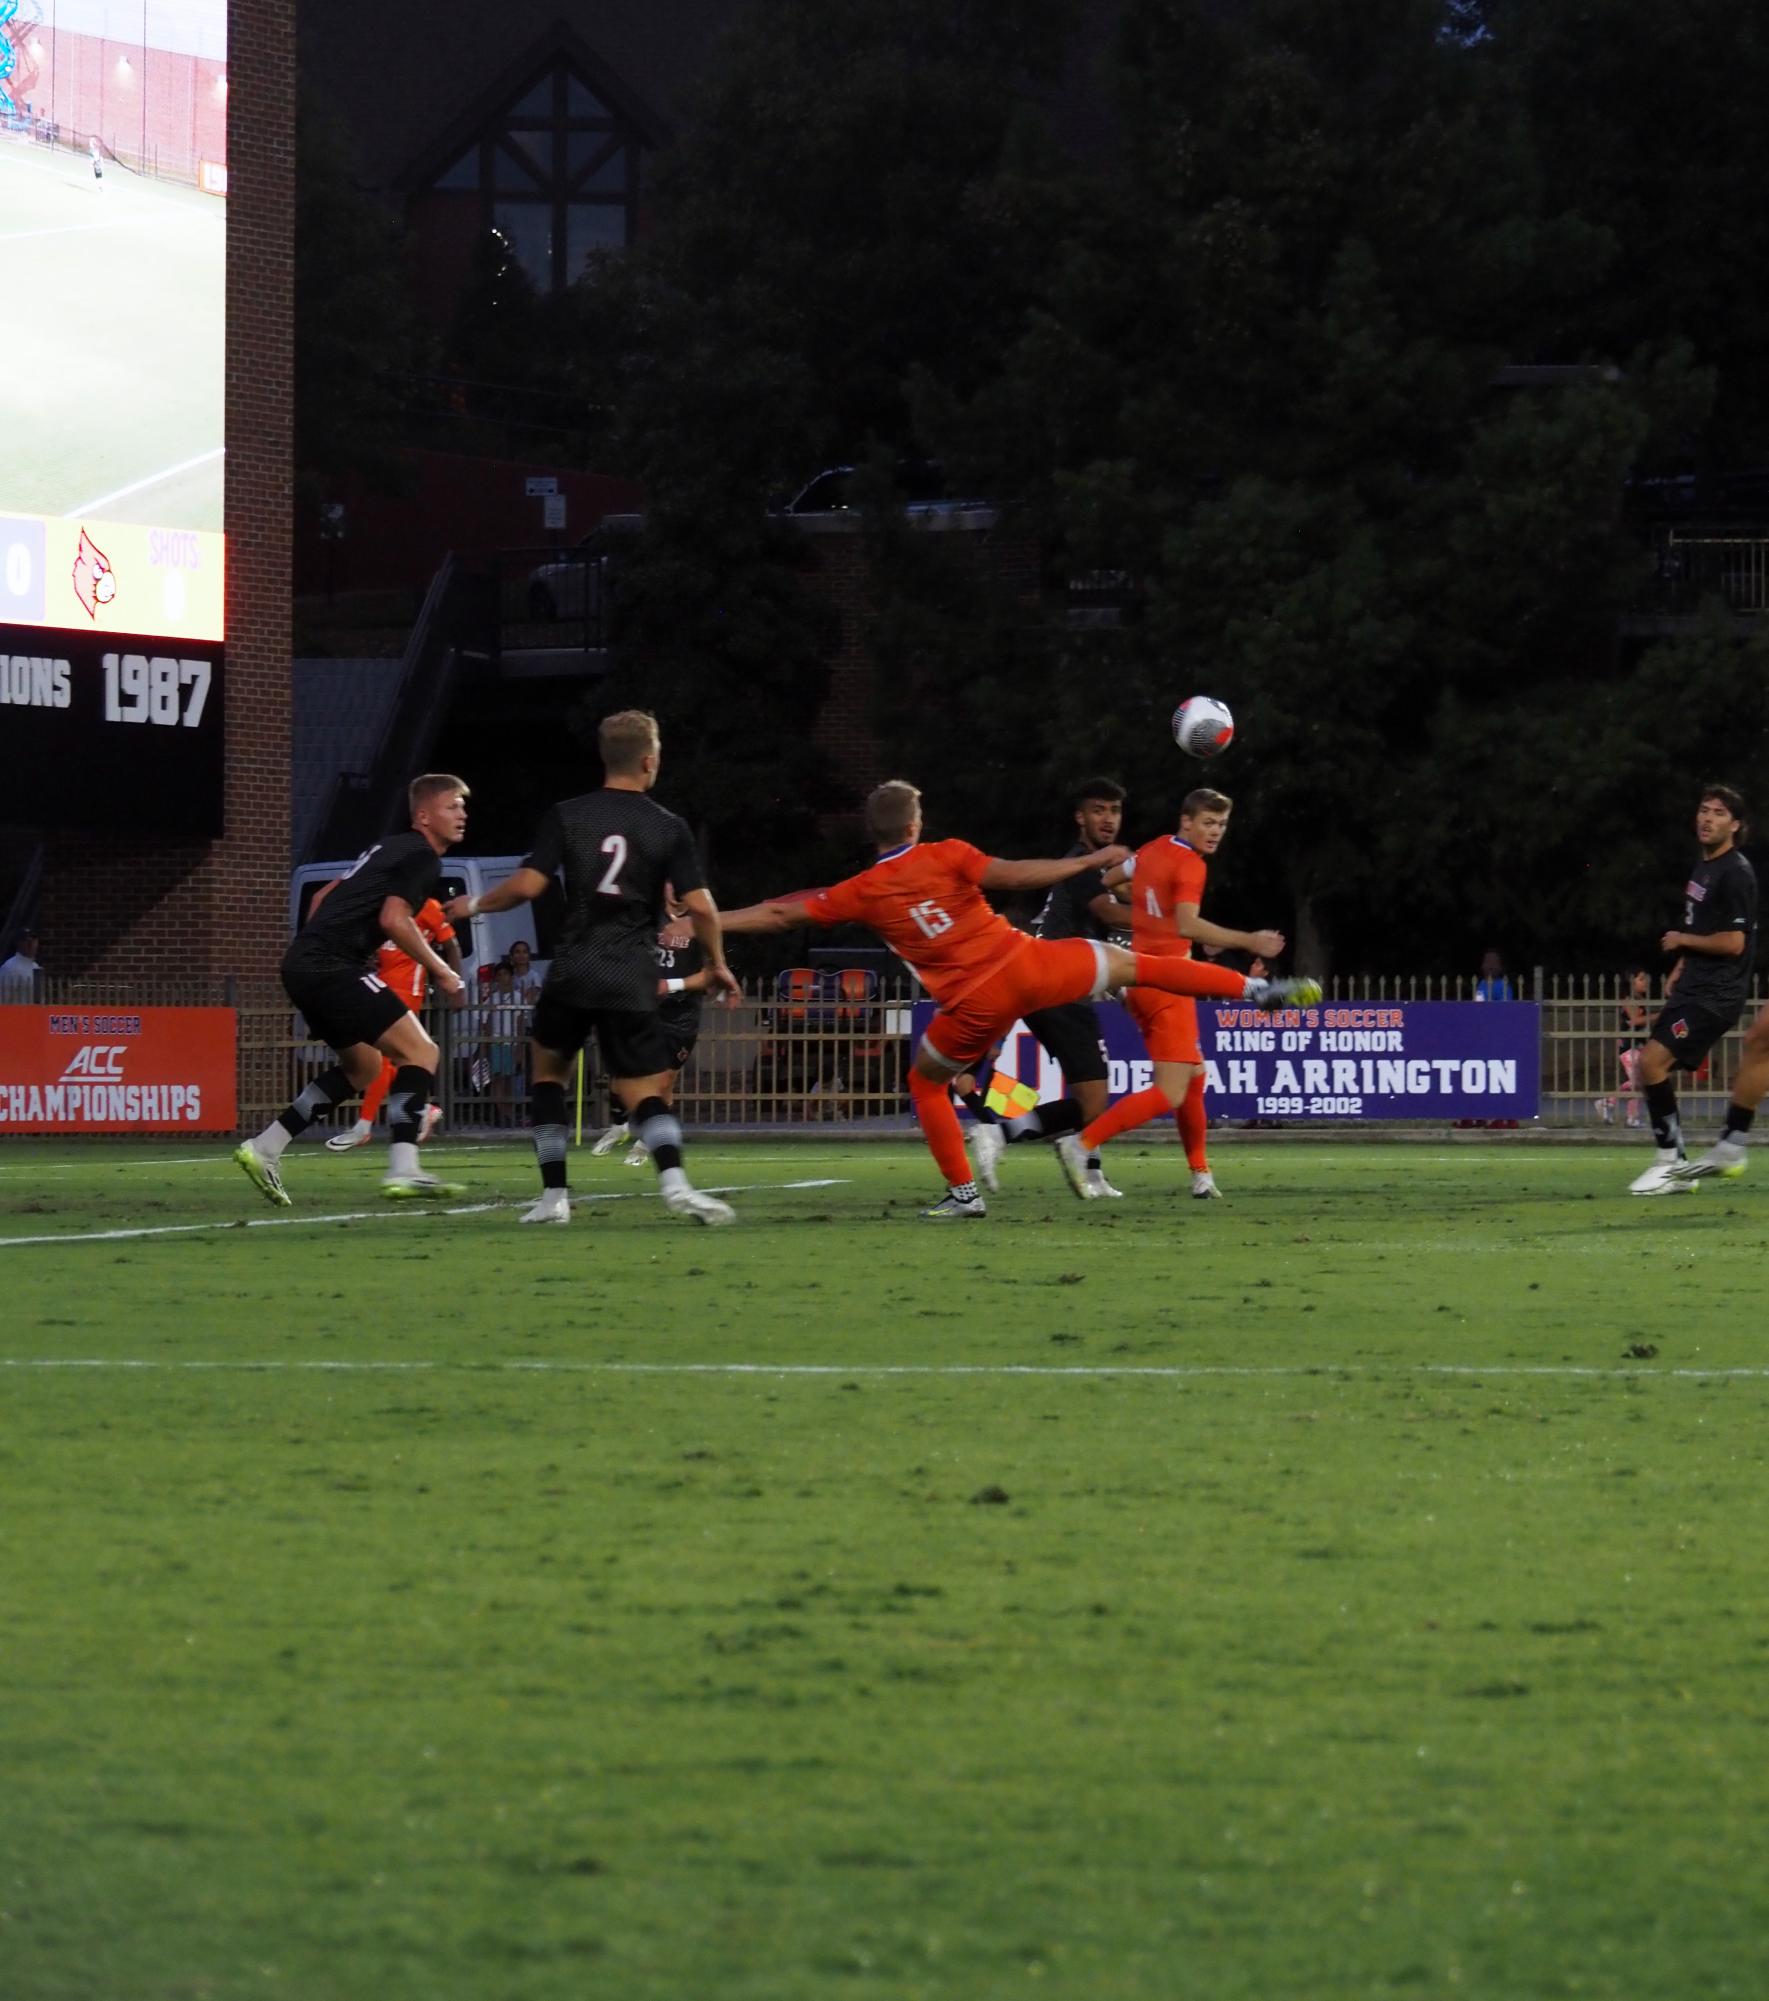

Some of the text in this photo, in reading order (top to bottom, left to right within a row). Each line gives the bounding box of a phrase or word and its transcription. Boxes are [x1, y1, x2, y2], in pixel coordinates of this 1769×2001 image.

[149, 528, 201, 570] SHOTS
[6, 542, 32, 596] 0
[102, 653, 211, 728] 1987
[597, 834, 627, 895] 2
[656, 948, 675, 968] 23
[93, 1015, 142, 1036] SOCCER
[1215, 1009, 1404, 1028] WOMEN'S SOCCER
[1215, 1031, 1404, 1052] RING OF HONOR
[64, 1046, 128, 1075] ACC
[1270, 1060, 1517, 1094] ARRINGTON
[1256, 1097, 1363, 1115] 1999-2002
